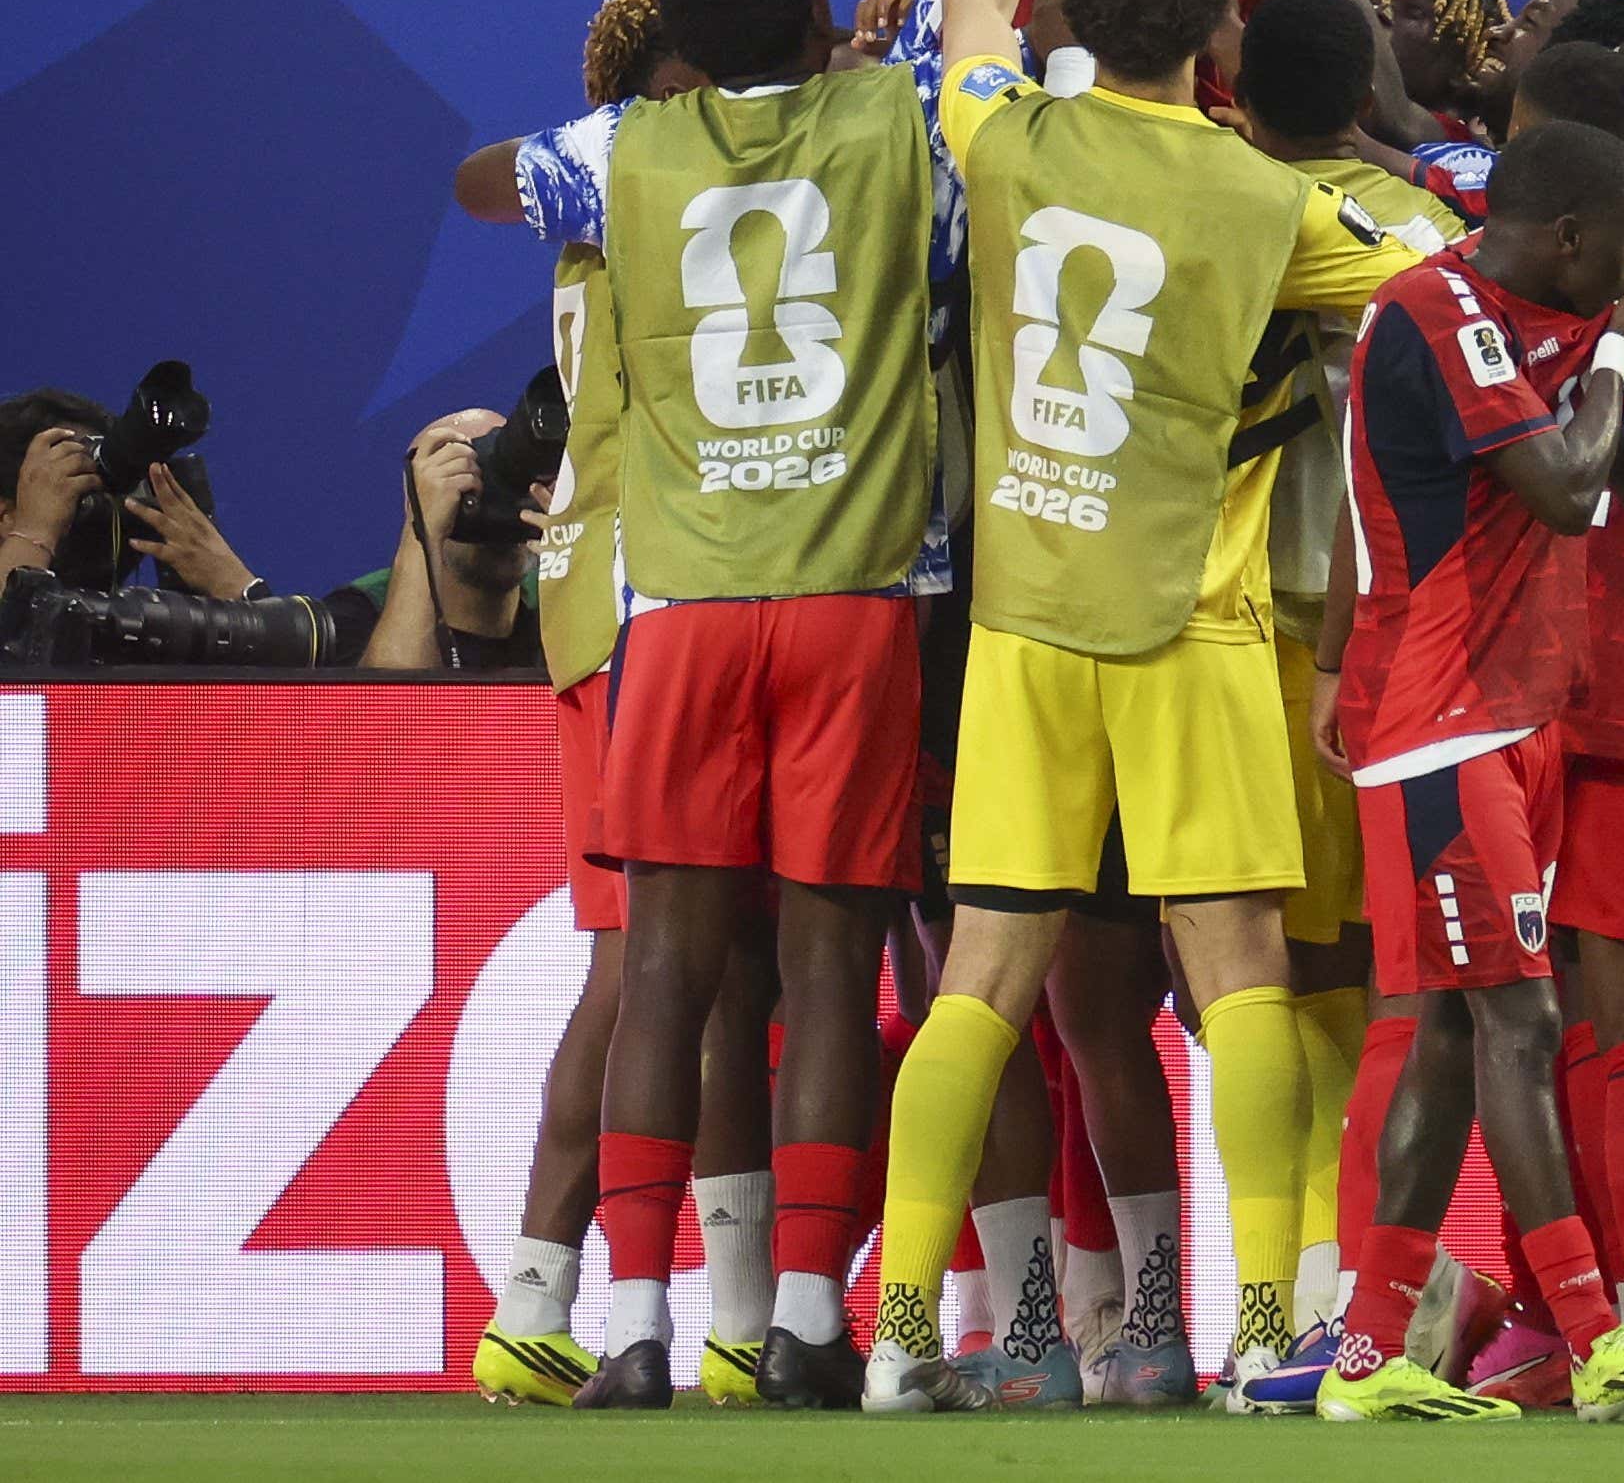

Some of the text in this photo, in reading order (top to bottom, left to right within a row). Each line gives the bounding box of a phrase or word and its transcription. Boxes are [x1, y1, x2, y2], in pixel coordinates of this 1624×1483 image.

[736, 375, 807, 405] FIFA
[1032, 398, 1087, 432] FIFA
[697, 427, 846, 459] WORLD CUP
[698, 452, 847, 493] 2026
[1063, 464, 1117, 494] CUP
[990, 474, 1109, 532] 2026
